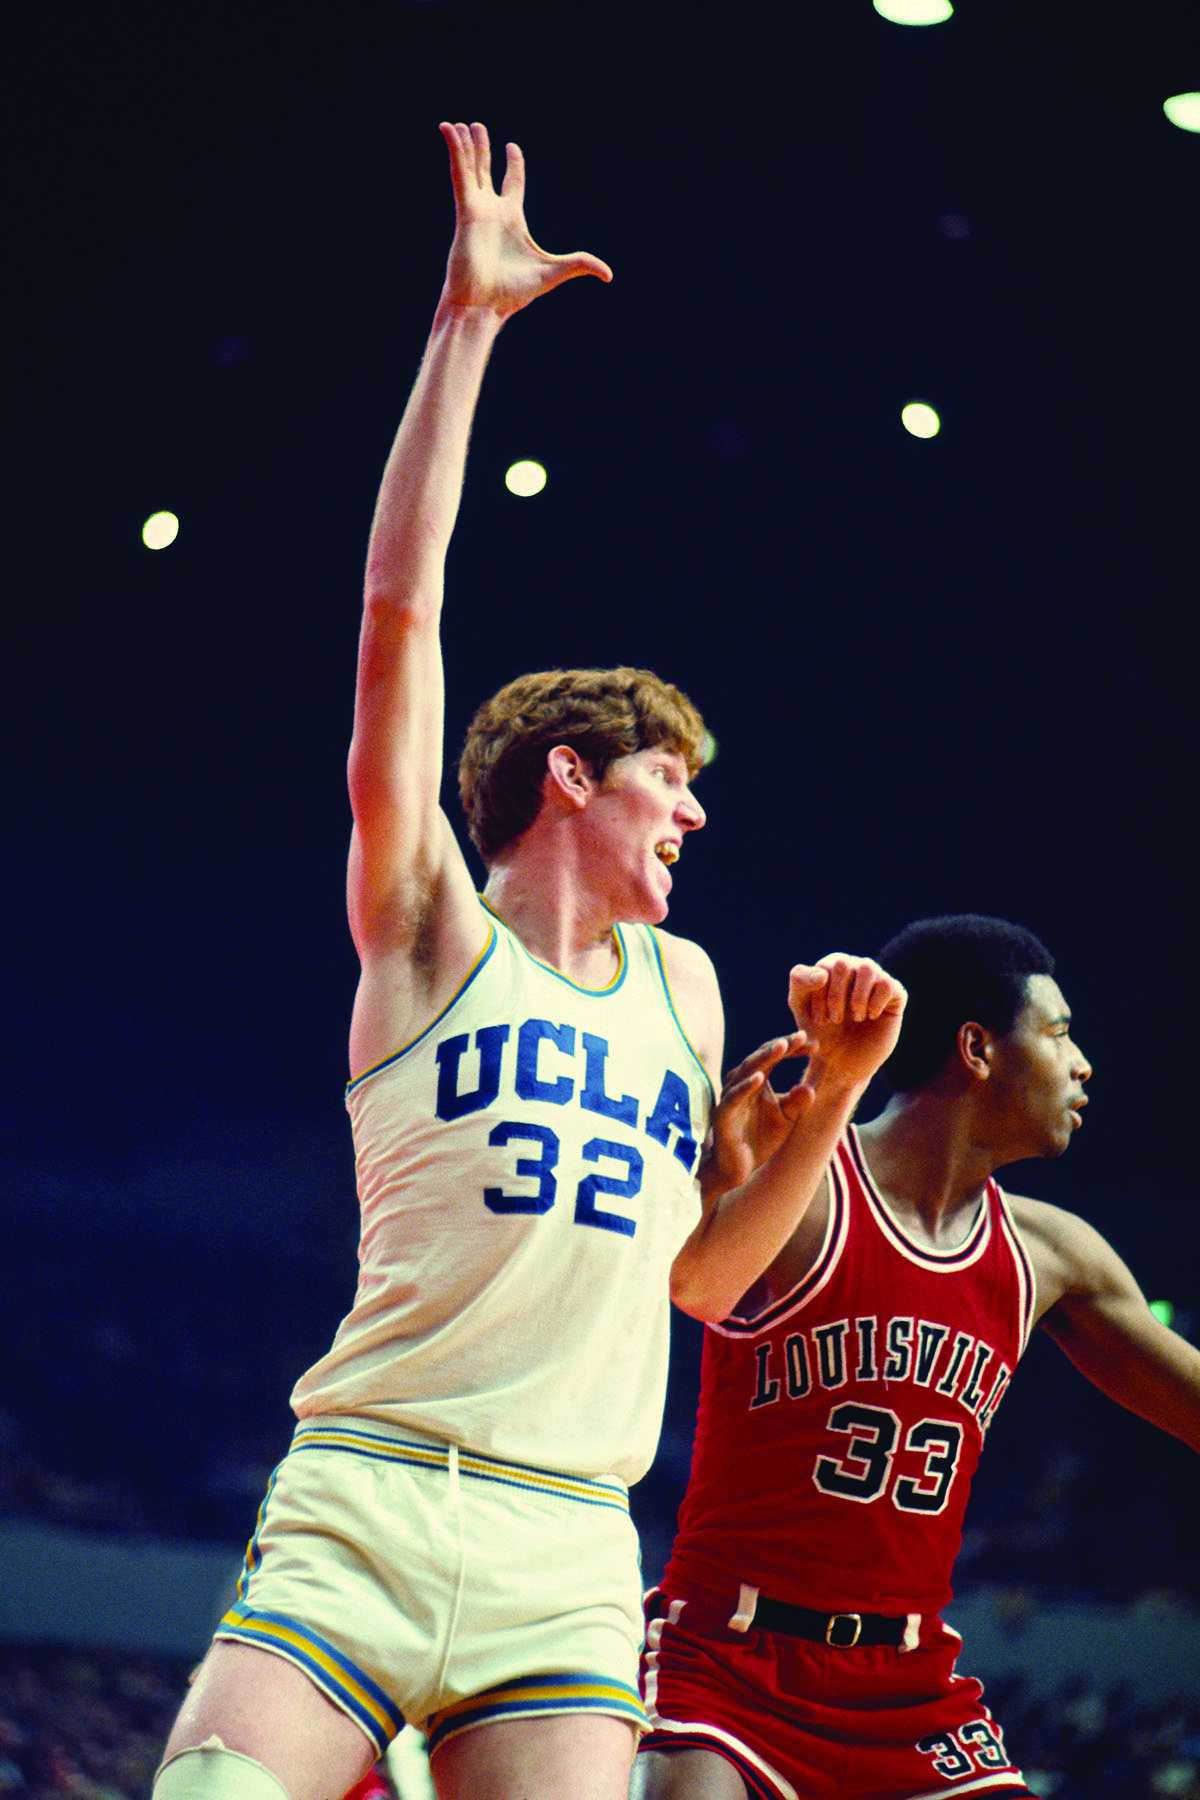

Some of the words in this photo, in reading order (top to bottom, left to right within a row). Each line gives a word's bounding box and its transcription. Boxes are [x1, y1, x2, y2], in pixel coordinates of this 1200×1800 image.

[435, 1018, 698, 1175] UCLA
[483, 1121, 644, 1238] 32
[748, 1315, 1011, 1431] LOUISVILL
[812, 1400, 964, 1516] 33
[915, 1718, 1011, 1780] 33
